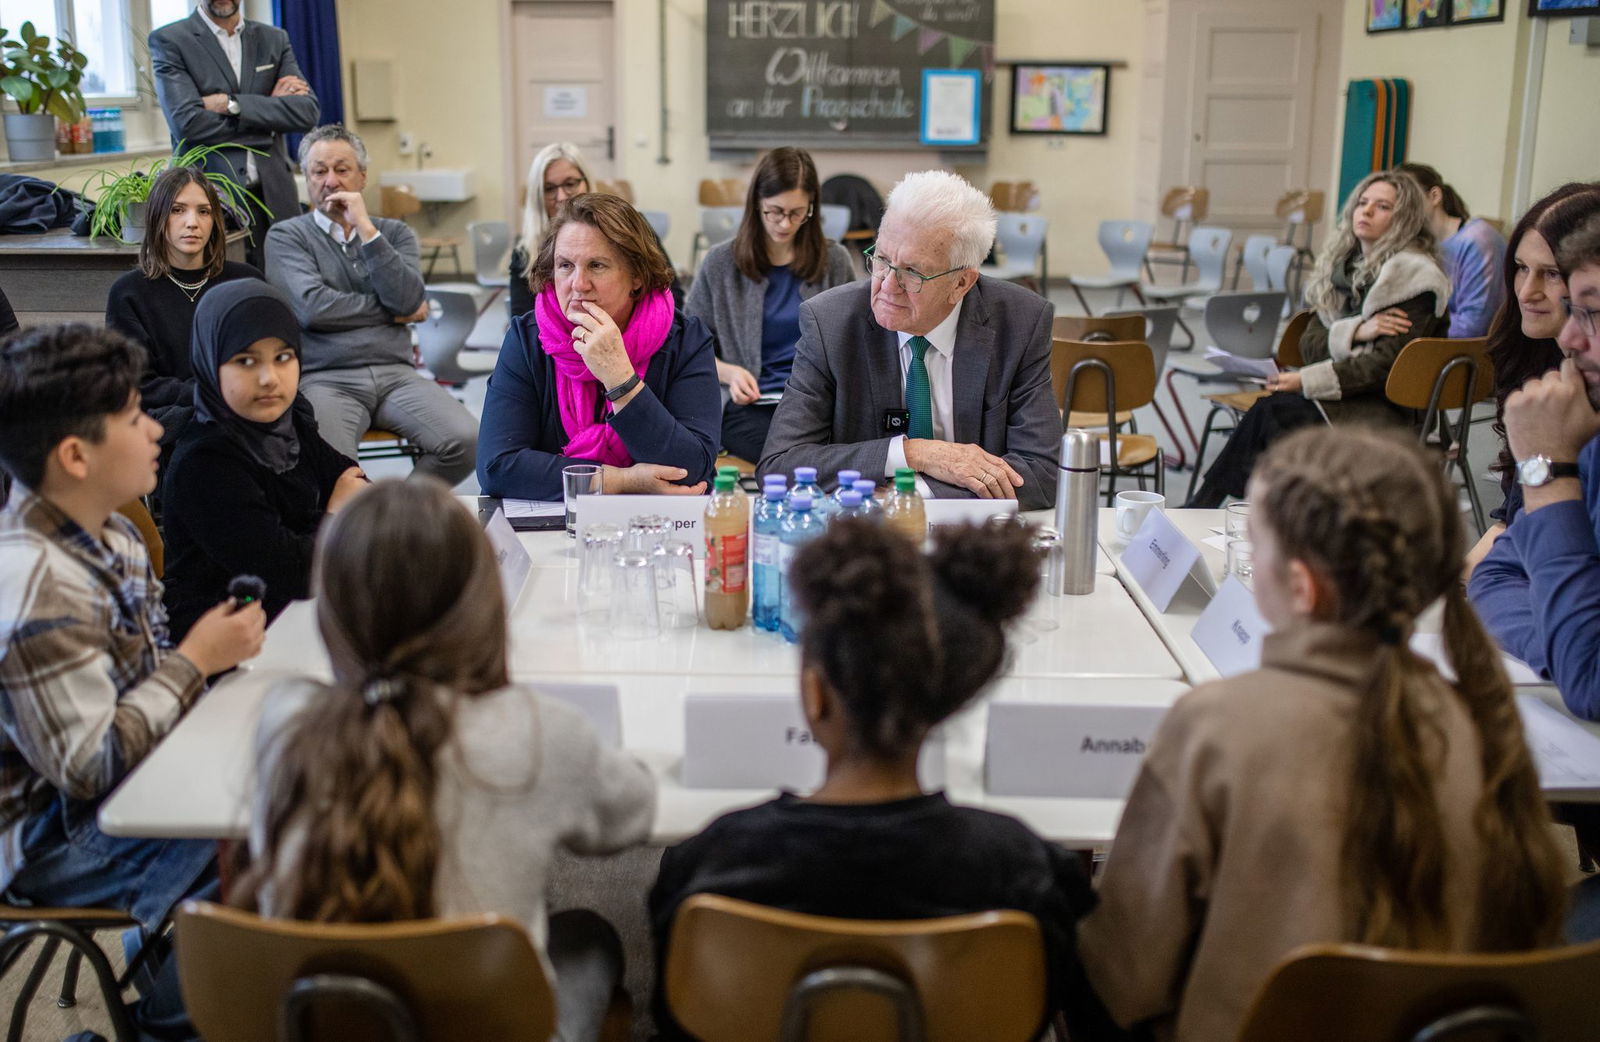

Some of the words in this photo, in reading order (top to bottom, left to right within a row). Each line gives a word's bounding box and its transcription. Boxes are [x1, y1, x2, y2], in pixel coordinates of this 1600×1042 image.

[728, 2, 860, 38] HERZLICH
[765, 47, 900, 86] Willkommen
[726, 98, 753, 118] an
[757, 89, 793, 118] der
[785, 726, 818, 746] Fa
[1080, 736, 1151, 754] Annab
